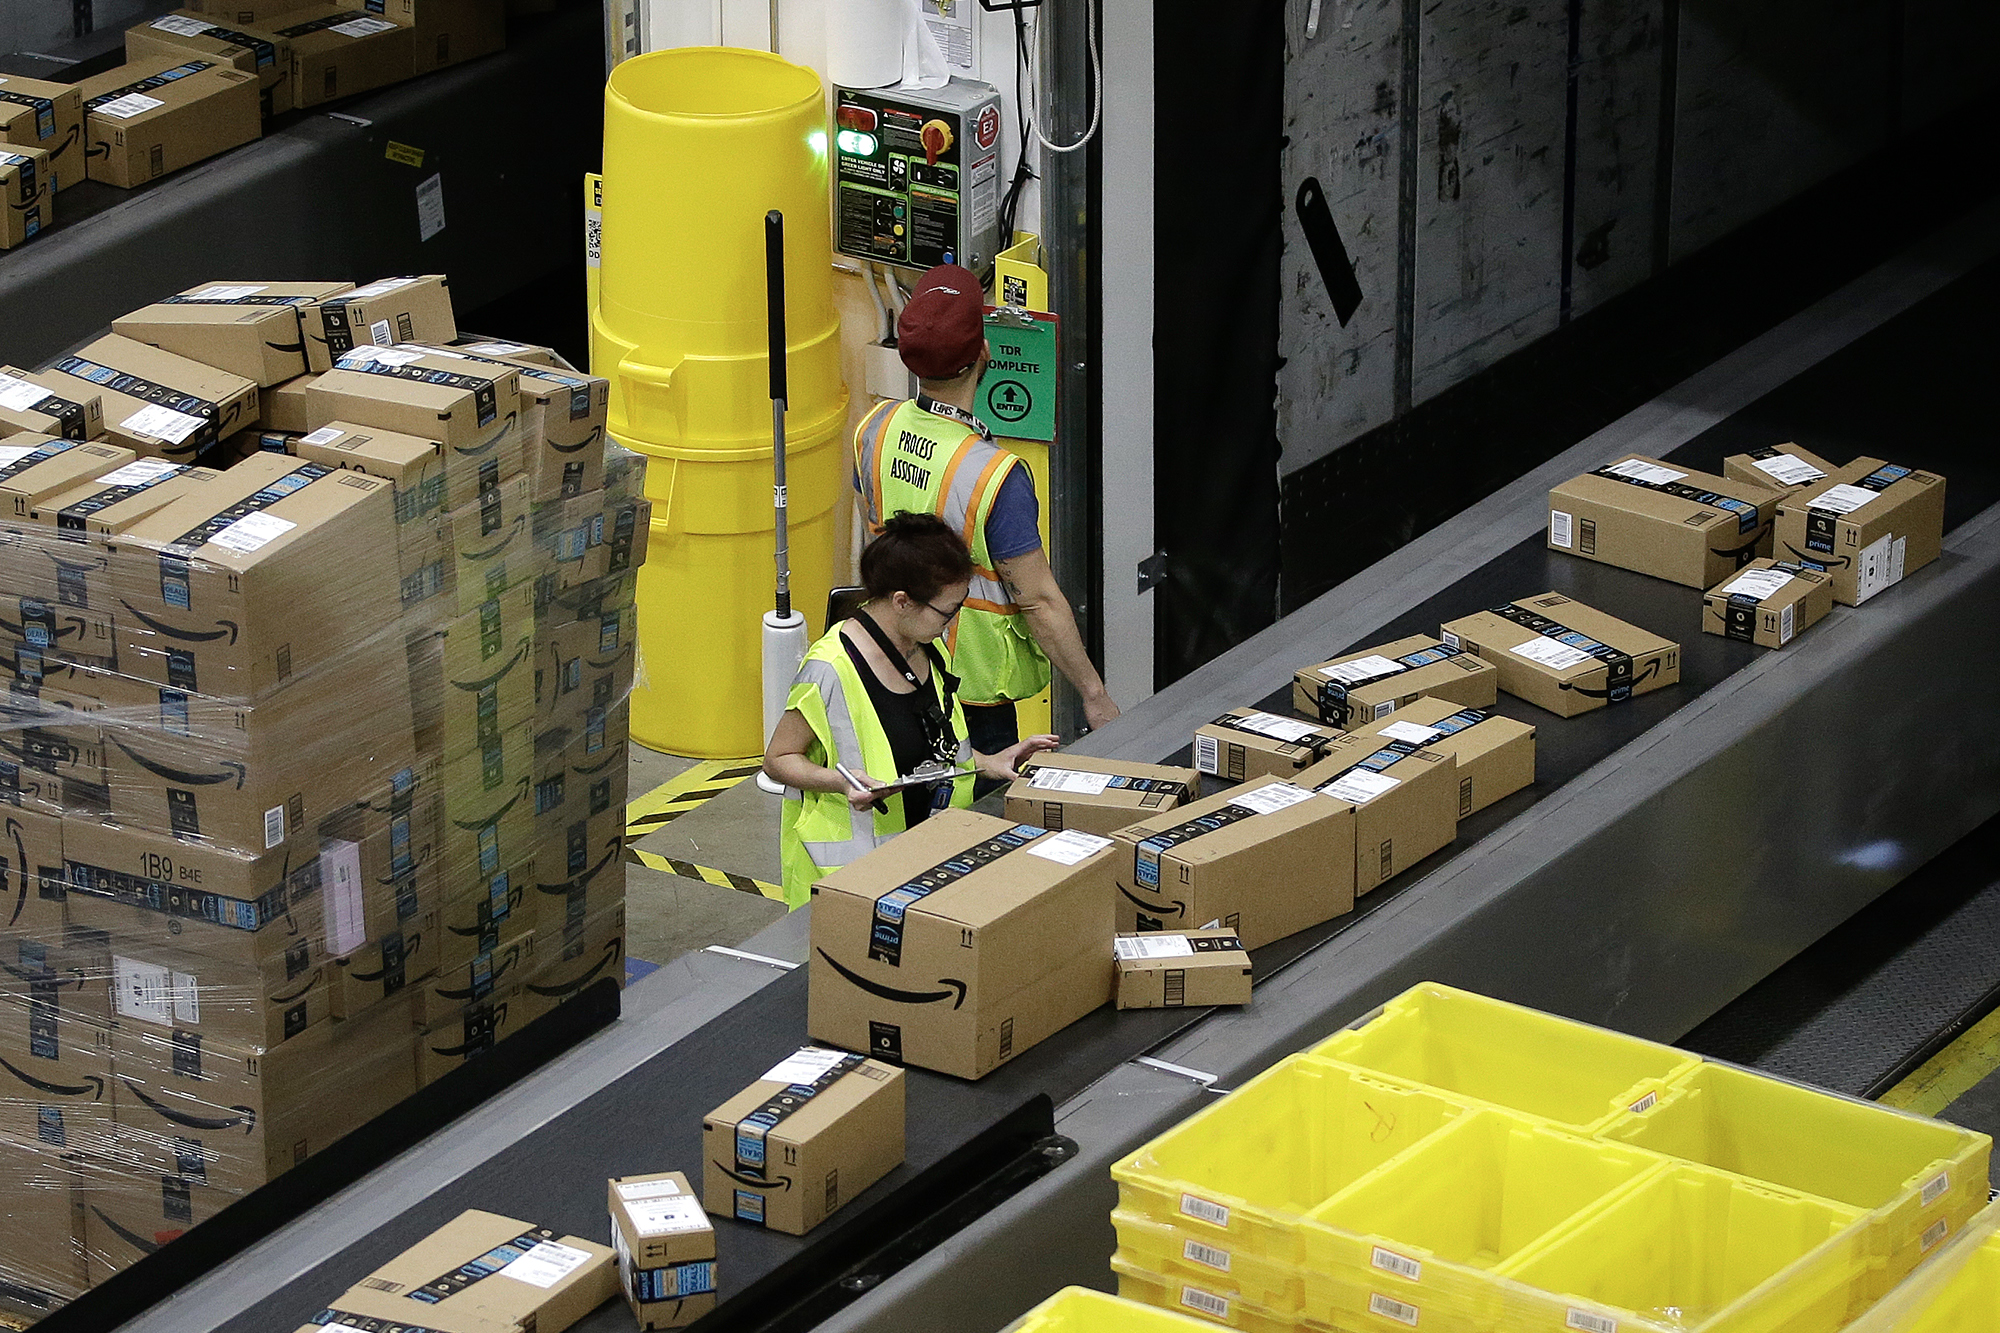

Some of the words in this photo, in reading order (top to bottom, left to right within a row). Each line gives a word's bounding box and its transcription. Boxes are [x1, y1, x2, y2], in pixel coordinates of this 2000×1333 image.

[983, 119, 994, 135] E2
[999, 345, 1021, 356] TDR
[988, 359, 1040, 374] OMPLETE
[996, 402, 1025, 412] ENTER
[898, 430, 938, 461] PROCESS
[1809, 540, 1832, 551] prime
[165, 586, 187, 597] DEALS
[27, 628, 48, 639] DEALS
[1327, 687, 1345, 700] prime
[1610, 685, 1630, 697] prime
[140, 852, 173, 882] 1B9
[180, 866, 202, 884] B4E
[879, 901, 902, 916] DEALS
[875, 931, 899, 945] prime
[640, 1271, 650, 1300] prime
